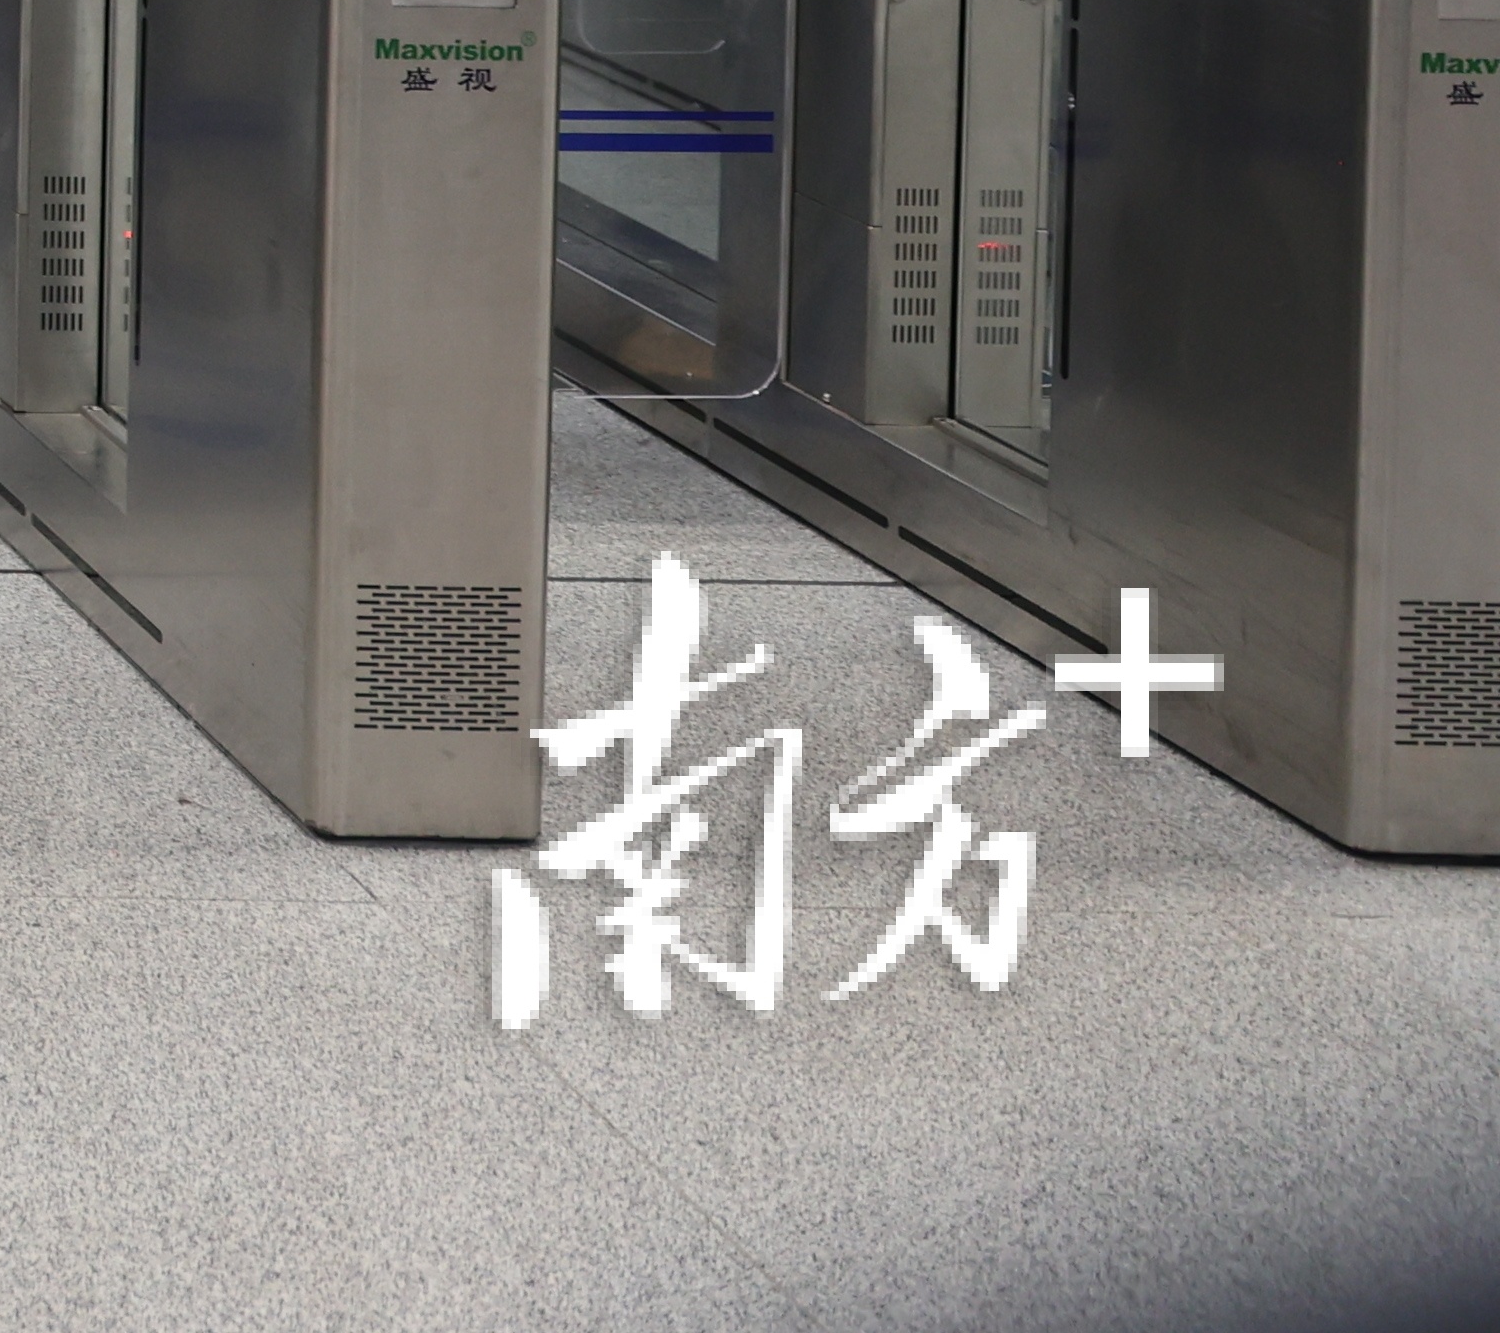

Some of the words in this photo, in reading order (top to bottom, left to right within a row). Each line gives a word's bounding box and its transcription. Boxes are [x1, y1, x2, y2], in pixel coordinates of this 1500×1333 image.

[375, 38, 524, 61] Maxvision
[1421, 52, 1500, 74] Maxv
[401, 67, 497, 92] 盛视
